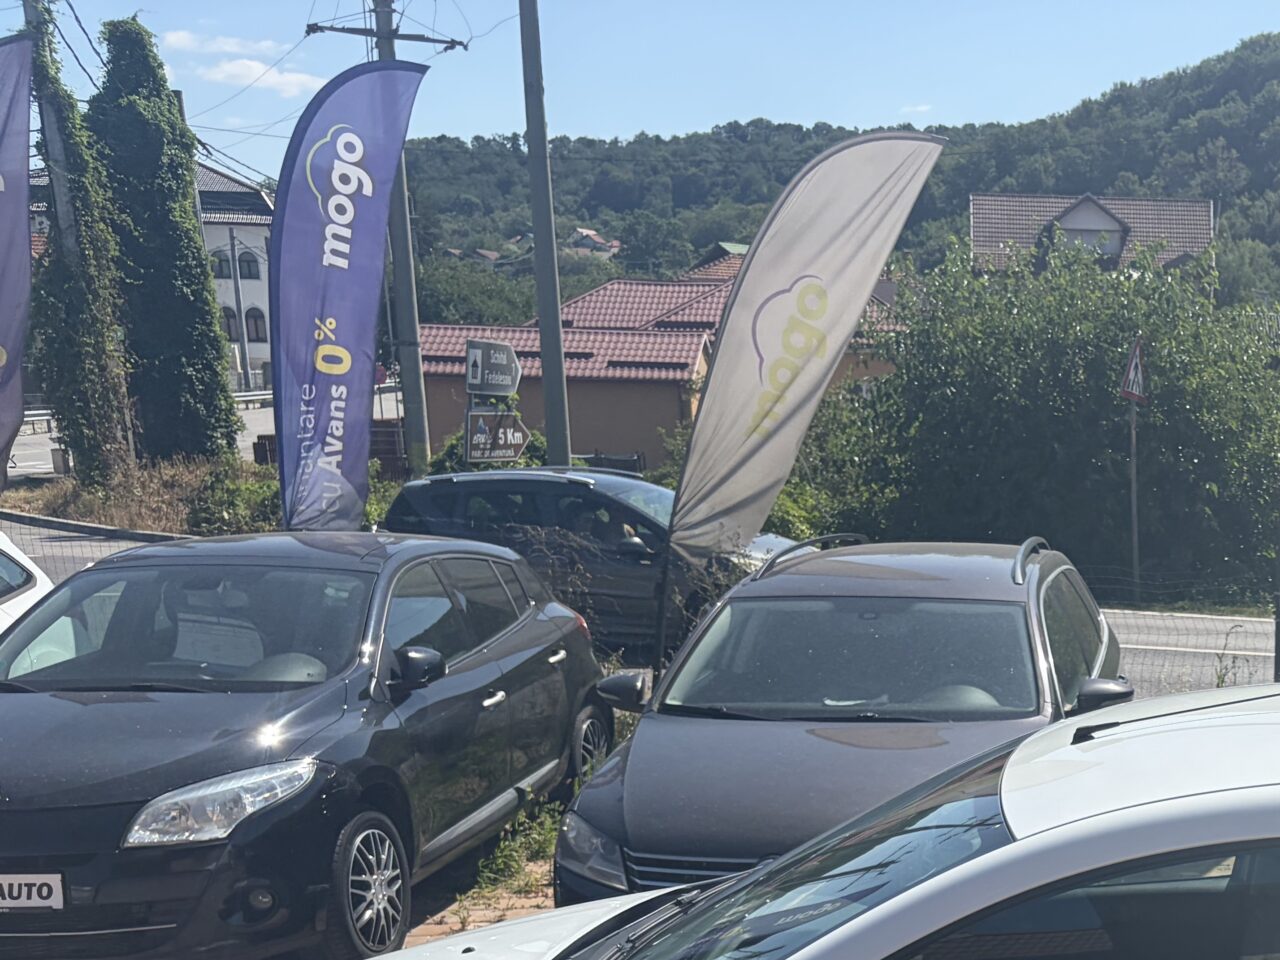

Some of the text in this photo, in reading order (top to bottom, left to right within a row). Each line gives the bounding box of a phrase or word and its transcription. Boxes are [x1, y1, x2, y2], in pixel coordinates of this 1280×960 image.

[323, 132, 373, 269] mogo
[743, 282, 829, 440] mogo
[316, 383, 348, 476] Avans
[499, 428, 505, 445] 5
[507, 427, 522, 445] Km
[321, 481, 343, 514] cu
